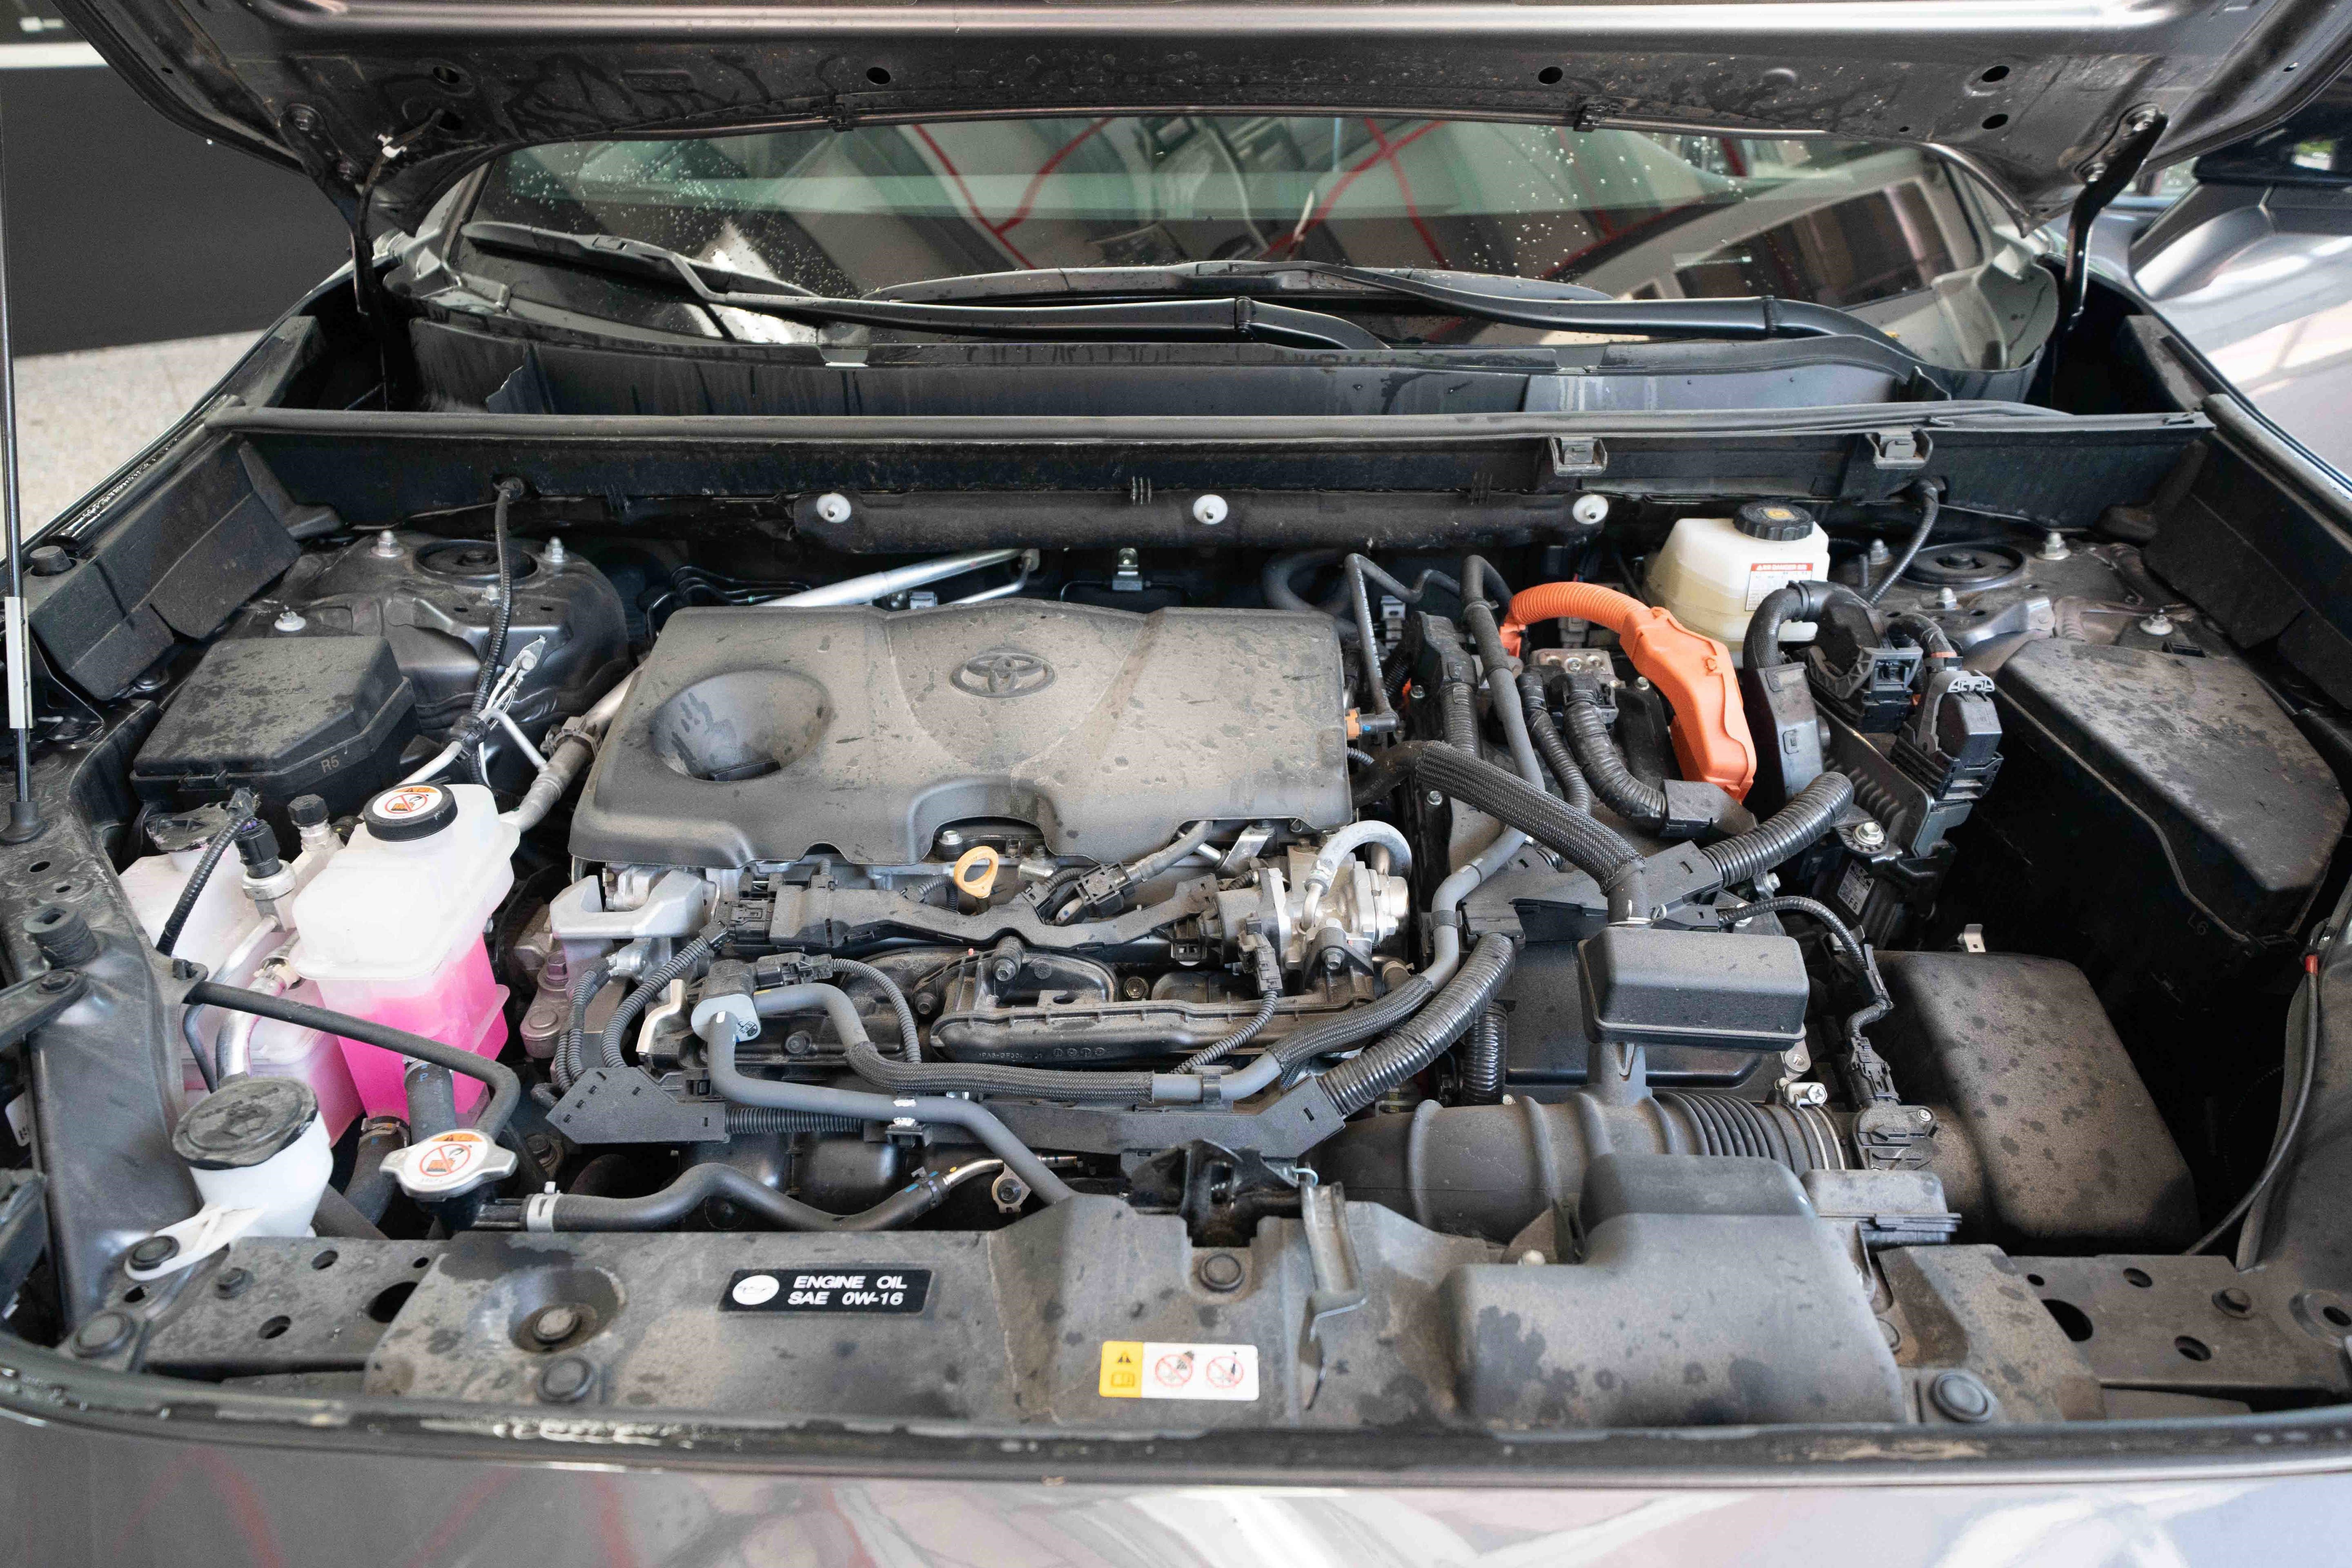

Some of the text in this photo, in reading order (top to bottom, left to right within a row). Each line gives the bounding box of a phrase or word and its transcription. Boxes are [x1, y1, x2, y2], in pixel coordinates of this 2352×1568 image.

[321, 755, 339, 774] R5
[793, 1276, 908, 1289] ENGINE OIL
[788, 1292, 904, 1305] SAE 0W-16
